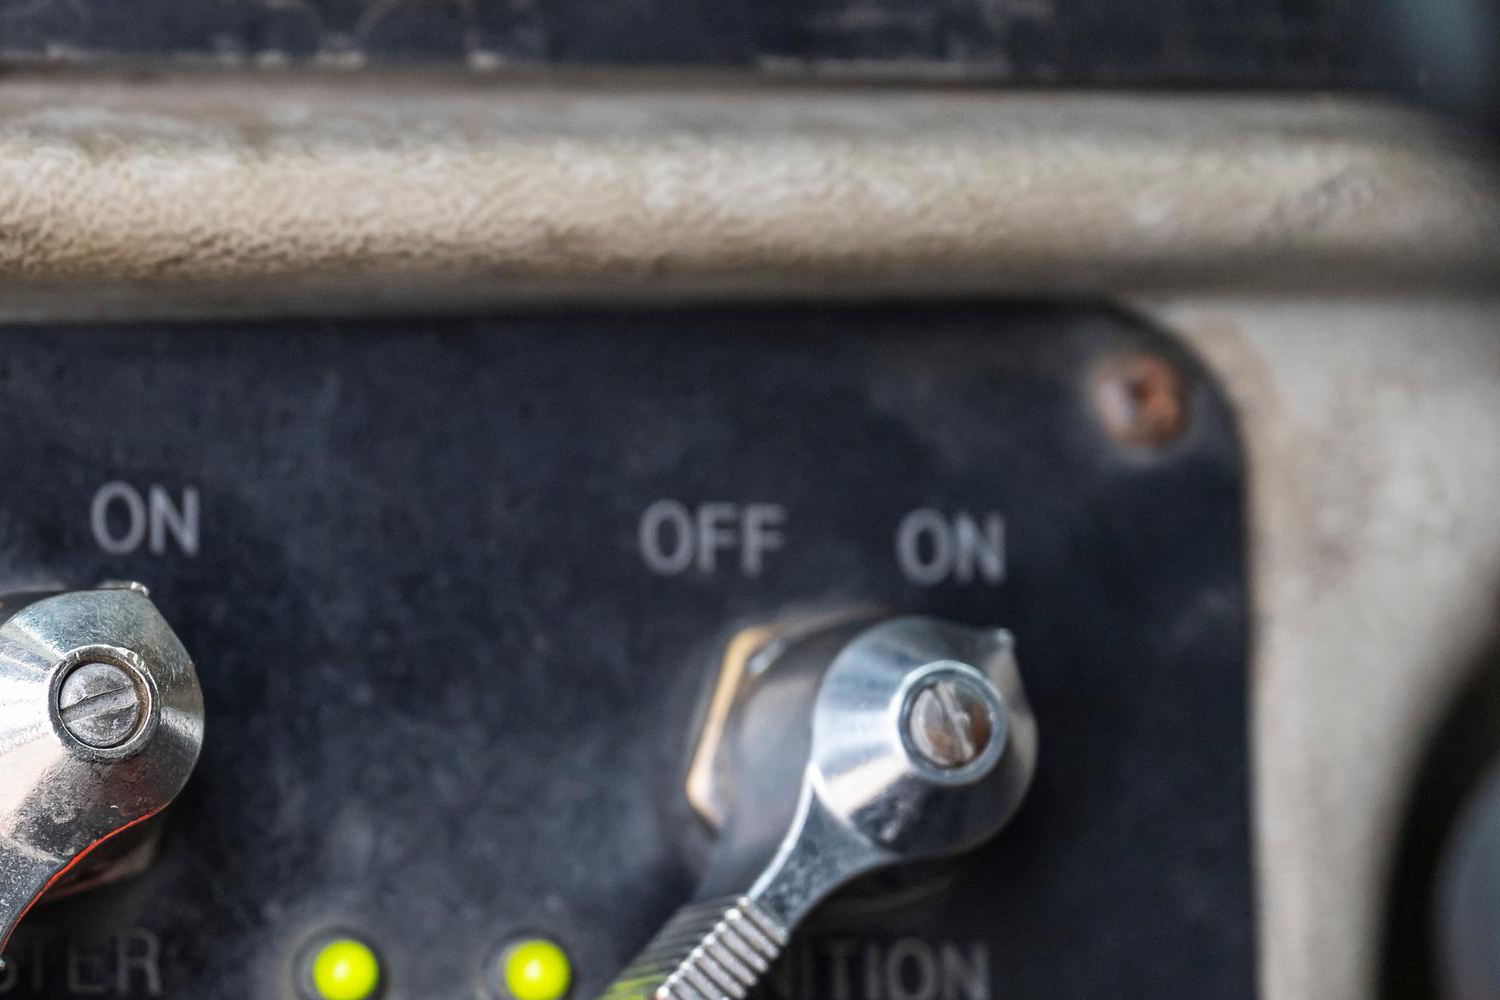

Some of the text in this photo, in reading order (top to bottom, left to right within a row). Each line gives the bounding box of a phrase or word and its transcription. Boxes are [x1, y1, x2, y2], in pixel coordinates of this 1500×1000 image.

[90, 480, 200, 557] ON
[637, 498, 1007, 587] OFF ON
